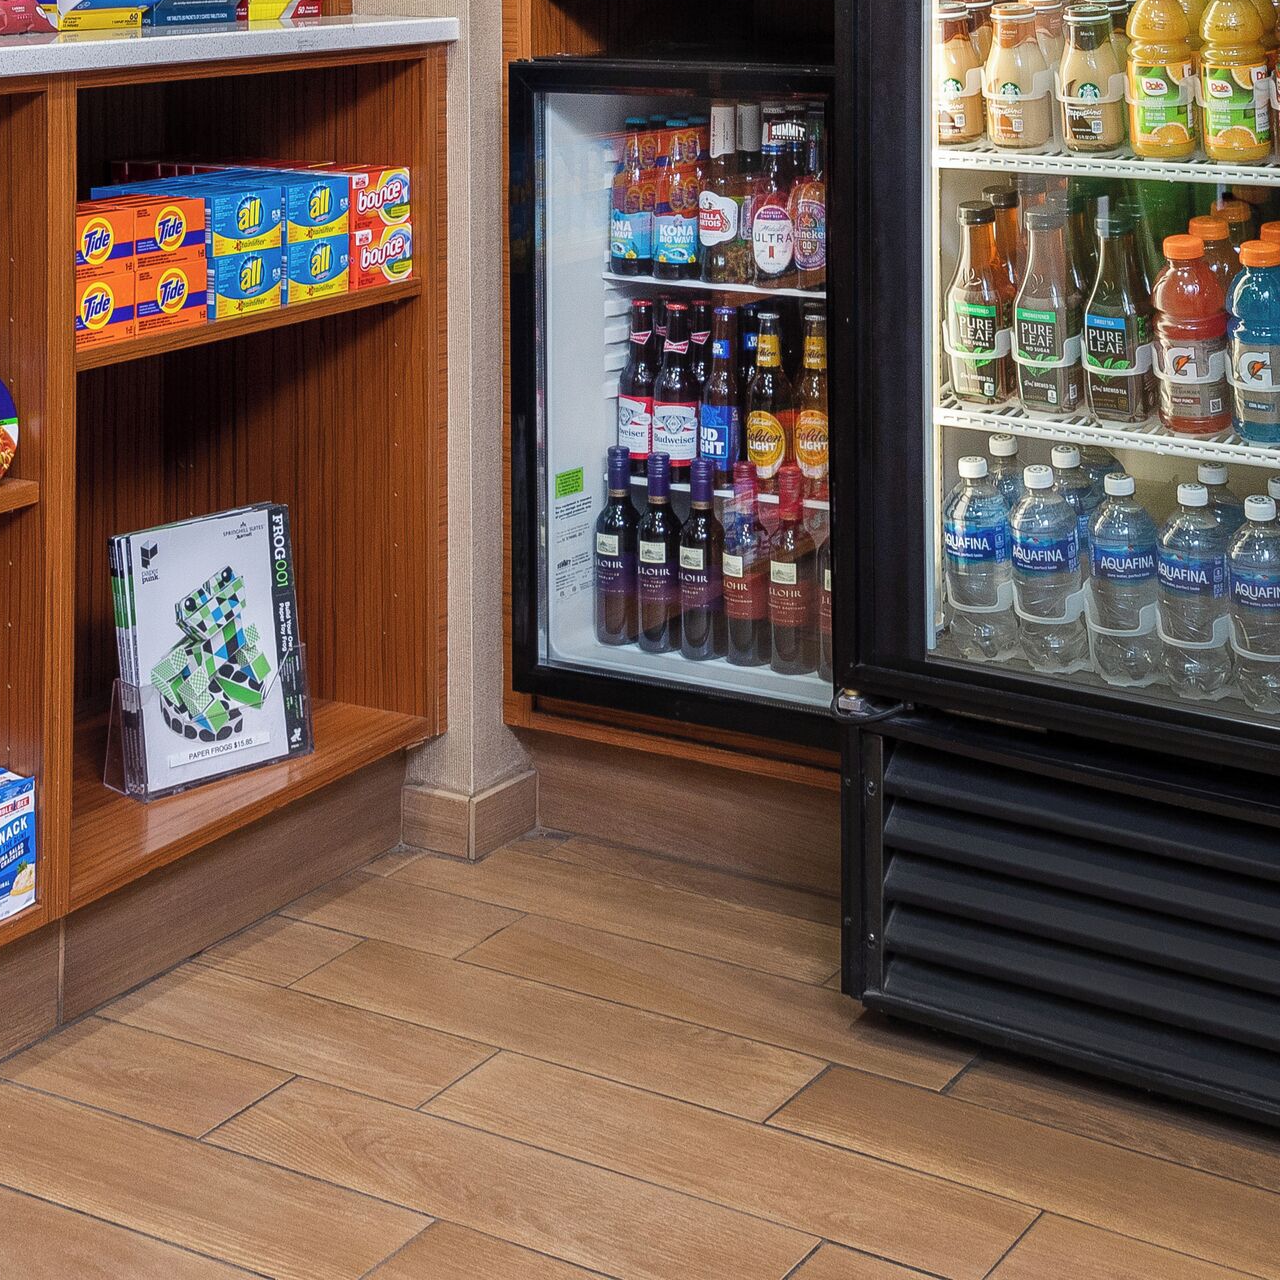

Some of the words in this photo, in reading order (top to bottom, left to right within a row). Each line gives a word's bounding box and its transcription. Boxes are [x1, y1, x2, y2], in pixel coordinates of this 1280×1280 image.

[297, 6, 305, 14] 50
[1145, 81, 1164, 91] Dole
[1210, 83, 1229, 93] Dole
[771, 124, 806, 136] SUMMIT
[310, 185, 331, 218] all
[358, 184, 403, 214] bounce
[238, 203, 261, 231] all
[157, 217, 184, 243] Tide
[659, 224, 694, 236] KONA
[754, 232, 793, 243] ULTRA
[83, 228, 111, 250] Tide
[310, 245, 332, 275] all
[360, 236, 405, 271] bounce
[240, 263, 263, 290] all
[160, 278, 185, 306] Tide
[83, 293, 111, 316] Tide
[960, 316, 992, 331] PURE
[1021, 322, 1053, 336] PURE
[960, 328, 993, 342] LEAF
[1022, 334, 1053, 347] LEAF
[1089, 328, 1123, 343] PURE
[1090, 341, 1123, 355] LEAF
[749, 441, 776, 450] LIGHT
[1012, 546, 1065, 564] AQUAFINA
[1100, 555, 1154, 572] AQUAFINA
[189, 750, 209, 760] PAPER
[210, 743, 233, 756] FROGS
[17, 797, 29, 810] BEE
[9, 842, 24, 858] SALAD
